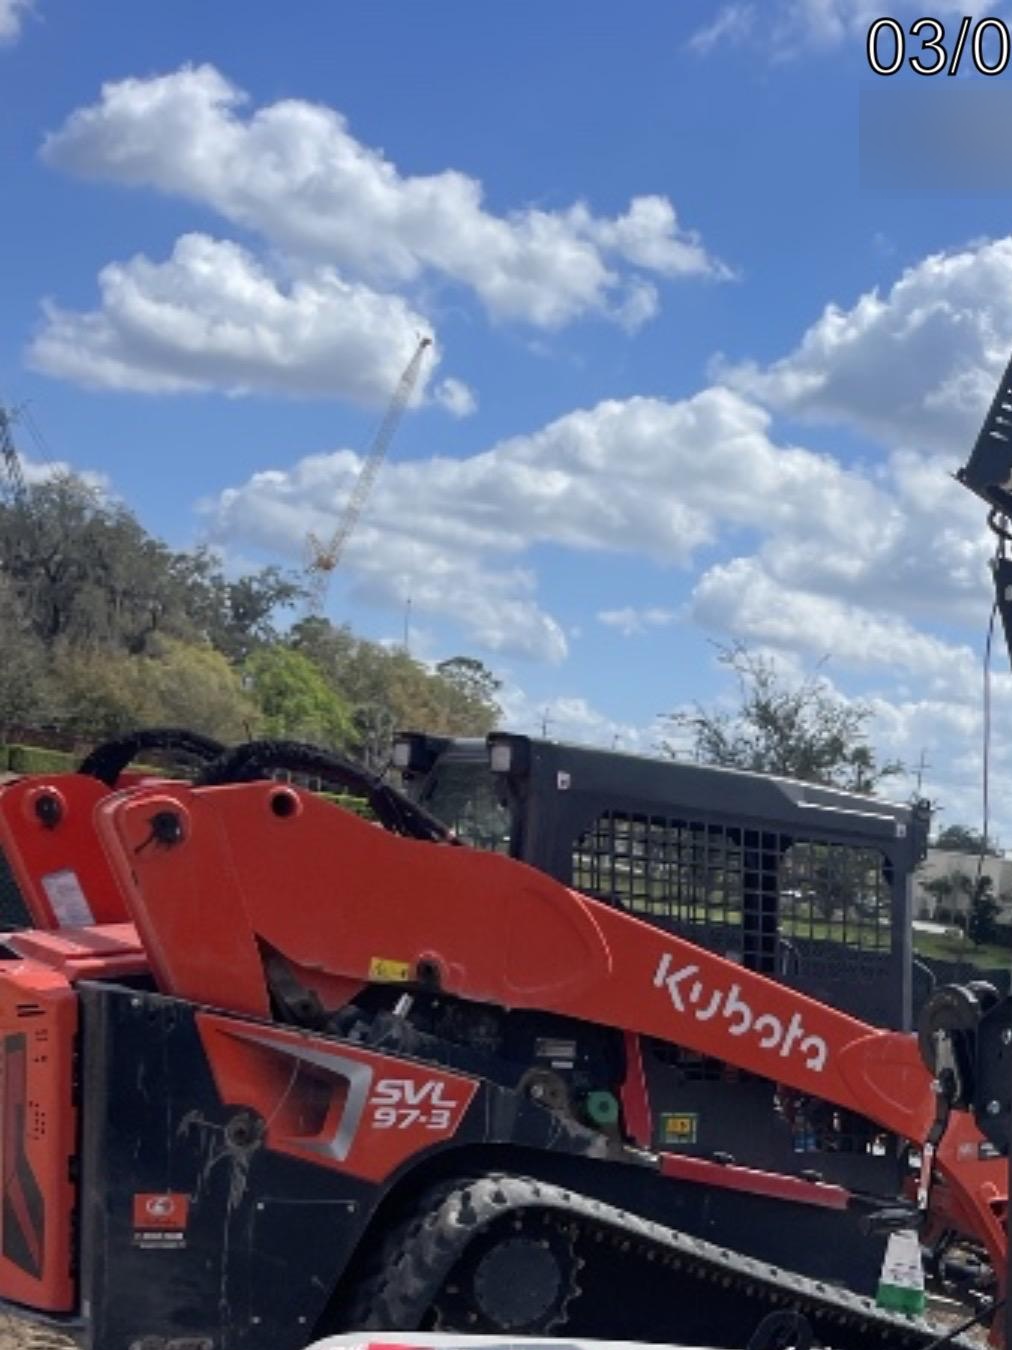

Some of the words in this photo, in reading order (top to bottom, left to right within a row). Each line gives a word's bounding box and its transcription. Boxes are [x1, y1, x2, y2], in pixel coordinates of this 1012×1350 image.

[653, 952, 827, 1072] Kubota
[370, 1079, 457, 1108] SVL
[372, 1106, 451, 1129] 97-3
